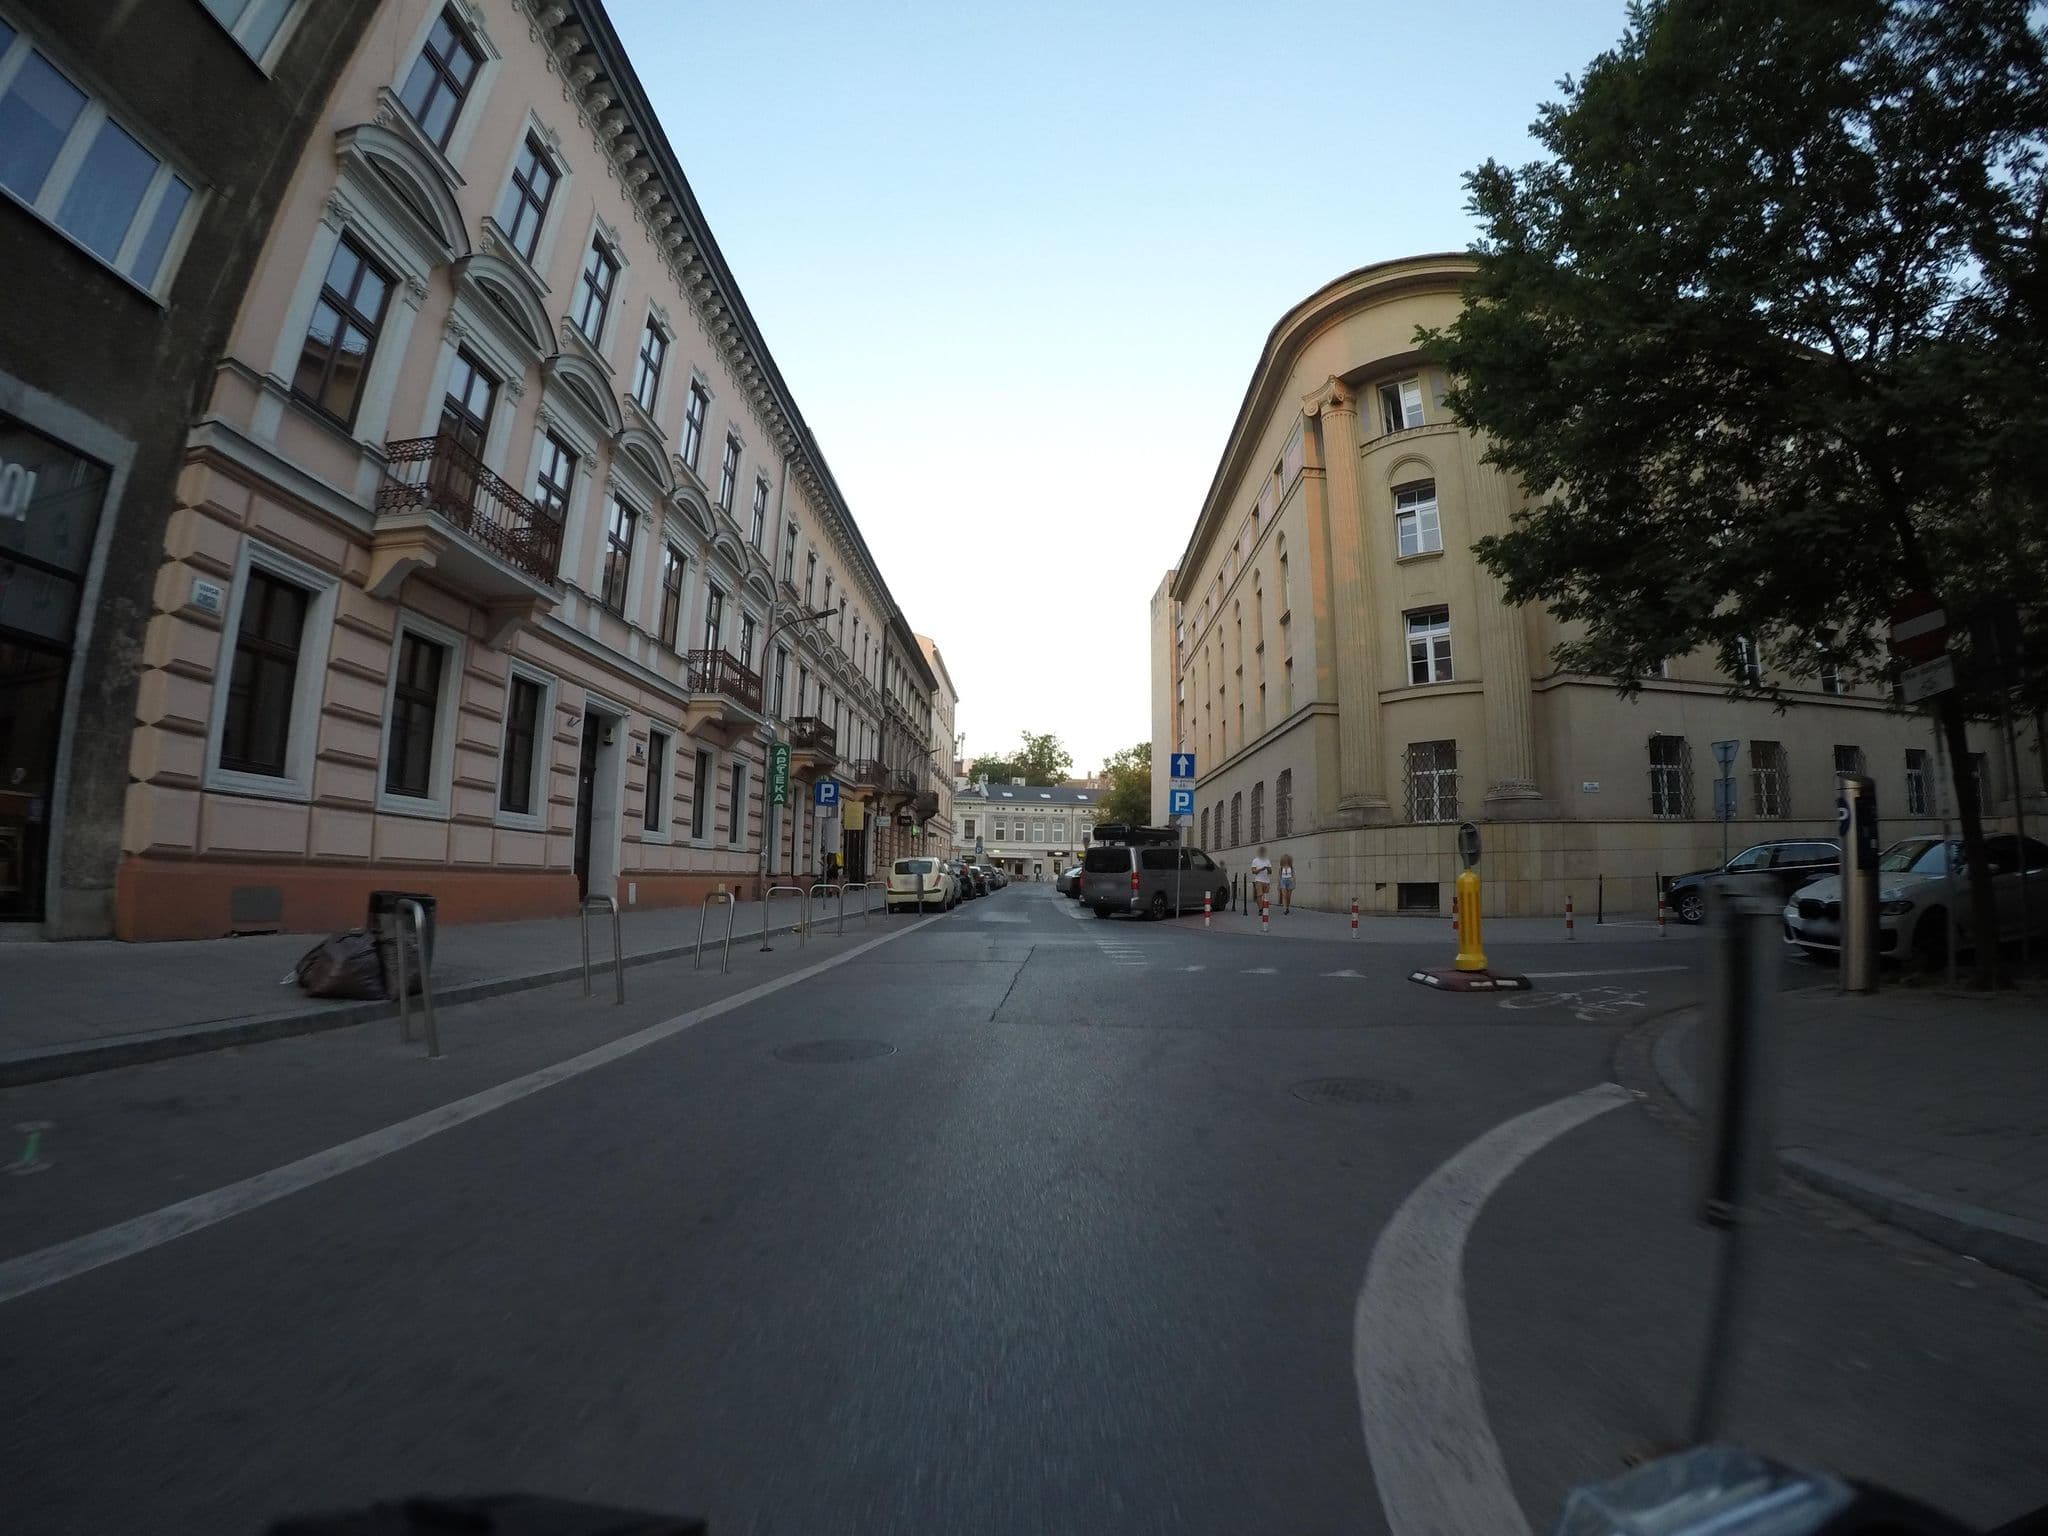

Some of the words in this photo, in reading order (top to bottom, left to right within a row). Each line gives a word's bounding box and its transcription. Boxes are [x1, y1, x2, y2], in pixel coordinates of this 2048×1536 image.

[774, 748, 787, 802] APTEKA
[821, 784, 834, 802] P
[1175, 792, 1190, 812] P
